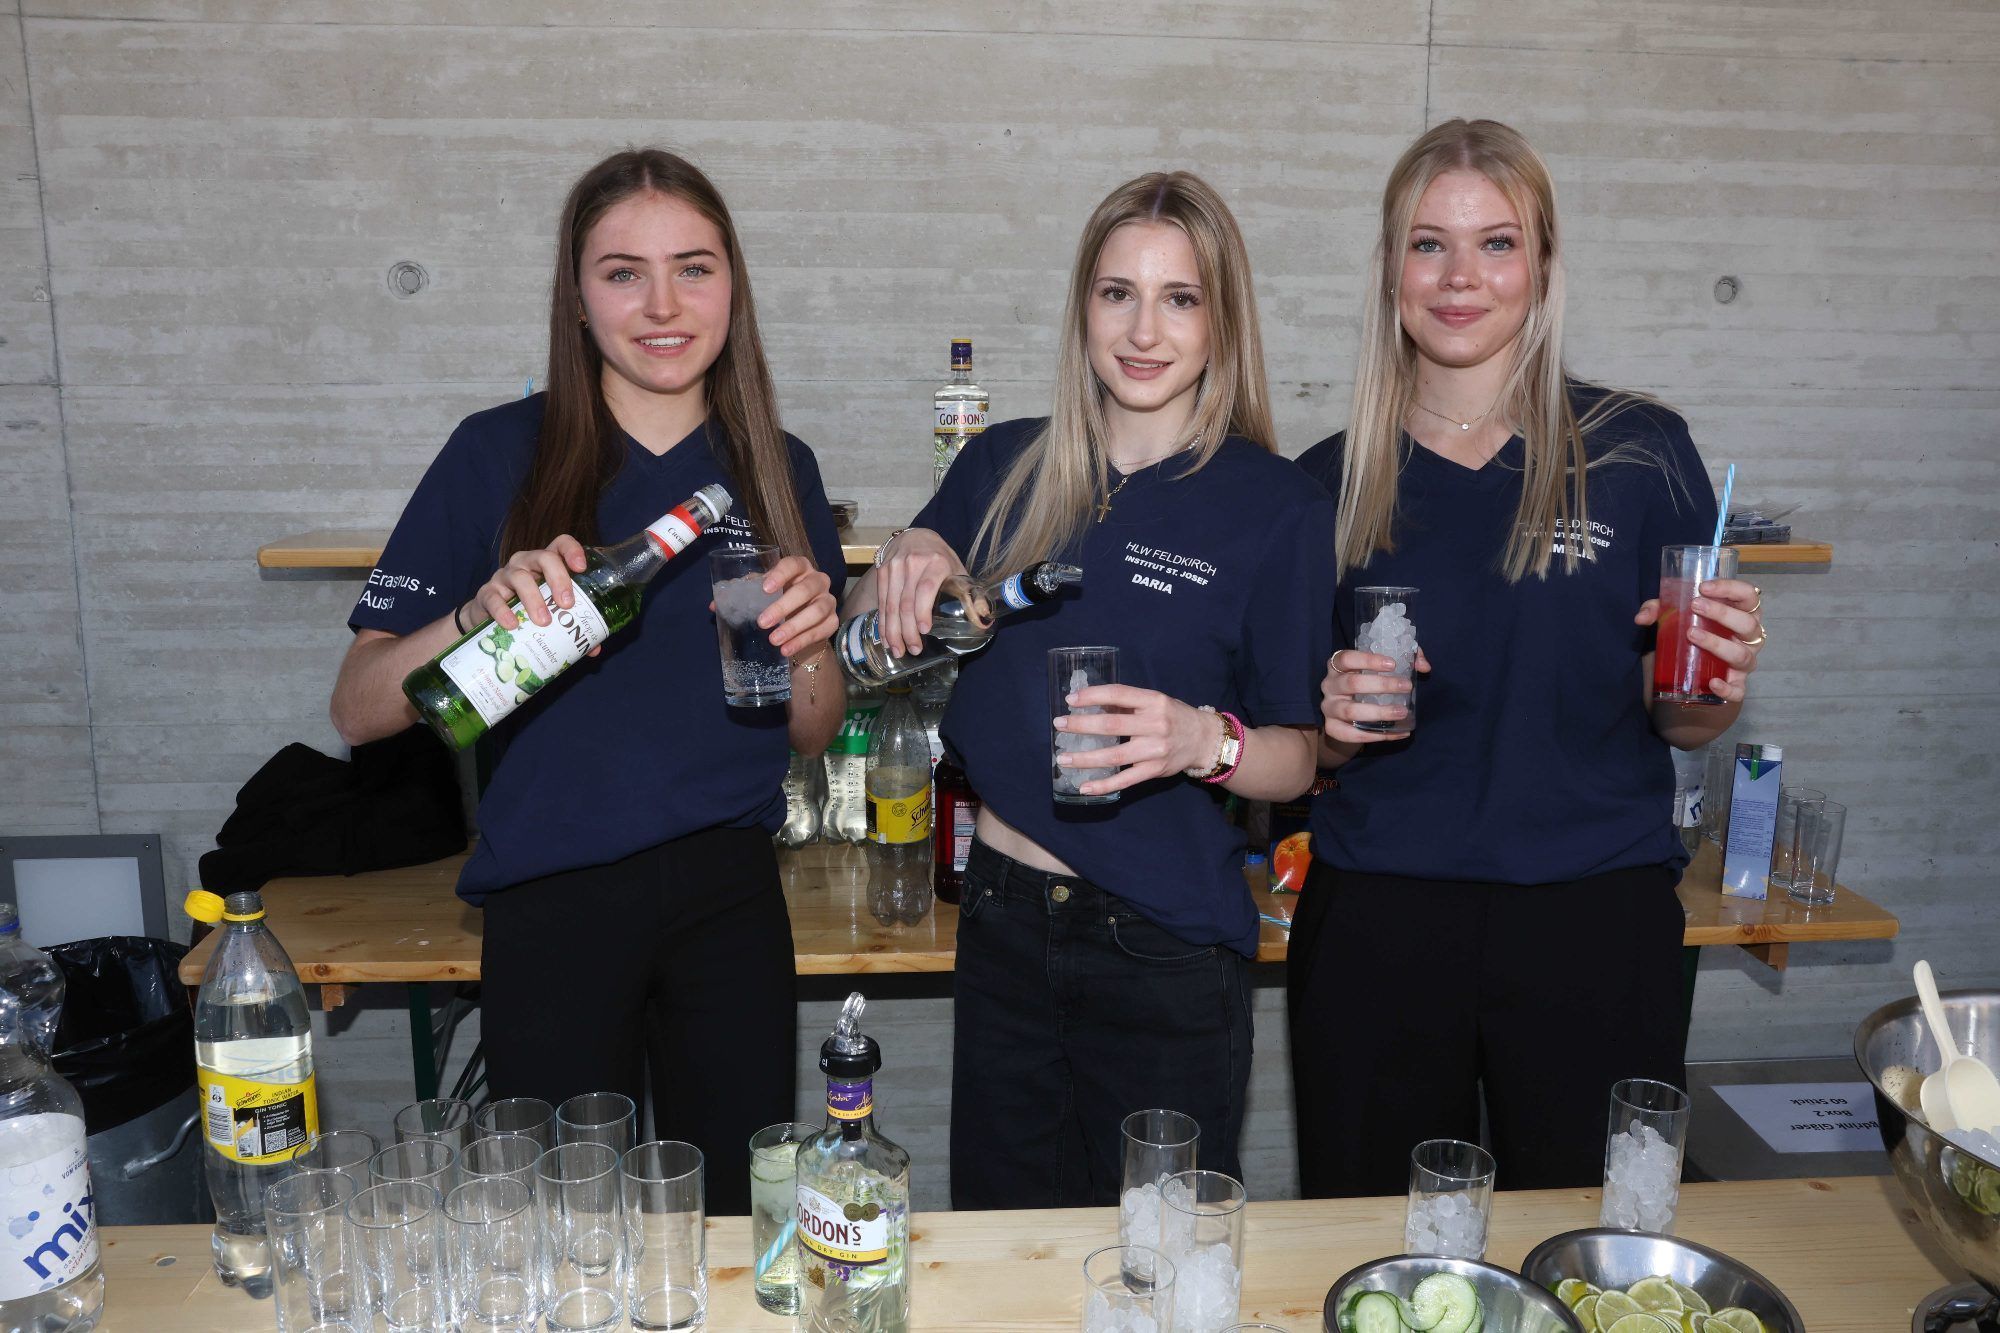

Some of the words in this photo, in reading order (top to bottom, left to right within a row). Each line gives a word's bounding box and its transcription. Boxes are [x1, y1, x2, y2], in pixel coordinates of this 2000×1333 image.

[939, 412, 985, 425] GORDON'S
[667, 527, 688, 547] Cucum
[703, 526, 743, 537] INSTITUT
[1125, 541, 1152, 556] HLW
[1152, 549, 1217, 577] FELDKIRCH
[1124, 555, 1165, 572] INSTITUT
[1166, 567, 1179, 577] ST.
[1180, 571, 1209, 586] JOSEF
[1131, 573, 1173, 595] DARIA
[532, 631, 558, 665] Cucumber
[263, 1096, 281, 1105] TONIC
[282, 1089, 300, 1101] WATER
[272, 1088, 292, 1098] INDIAN
[254, 1106, 267, 1114] GIN
[268, 1102, 287, 1111] TONIC
[1790, 1098, 1828, 1106] Stück
[1812, 1109, 1825, 1117] 2
[1825, 1109, 1854, 1117] Box
[1790, 1122, 1835, 1131] Gläser
[1835, 1120, 1881, 1131] gdrink
[22, 1178, 95, 1280] mix
[798, 1202, 862, 1246] ORDON'S
[817, 1244, 833, 1254] DRY
